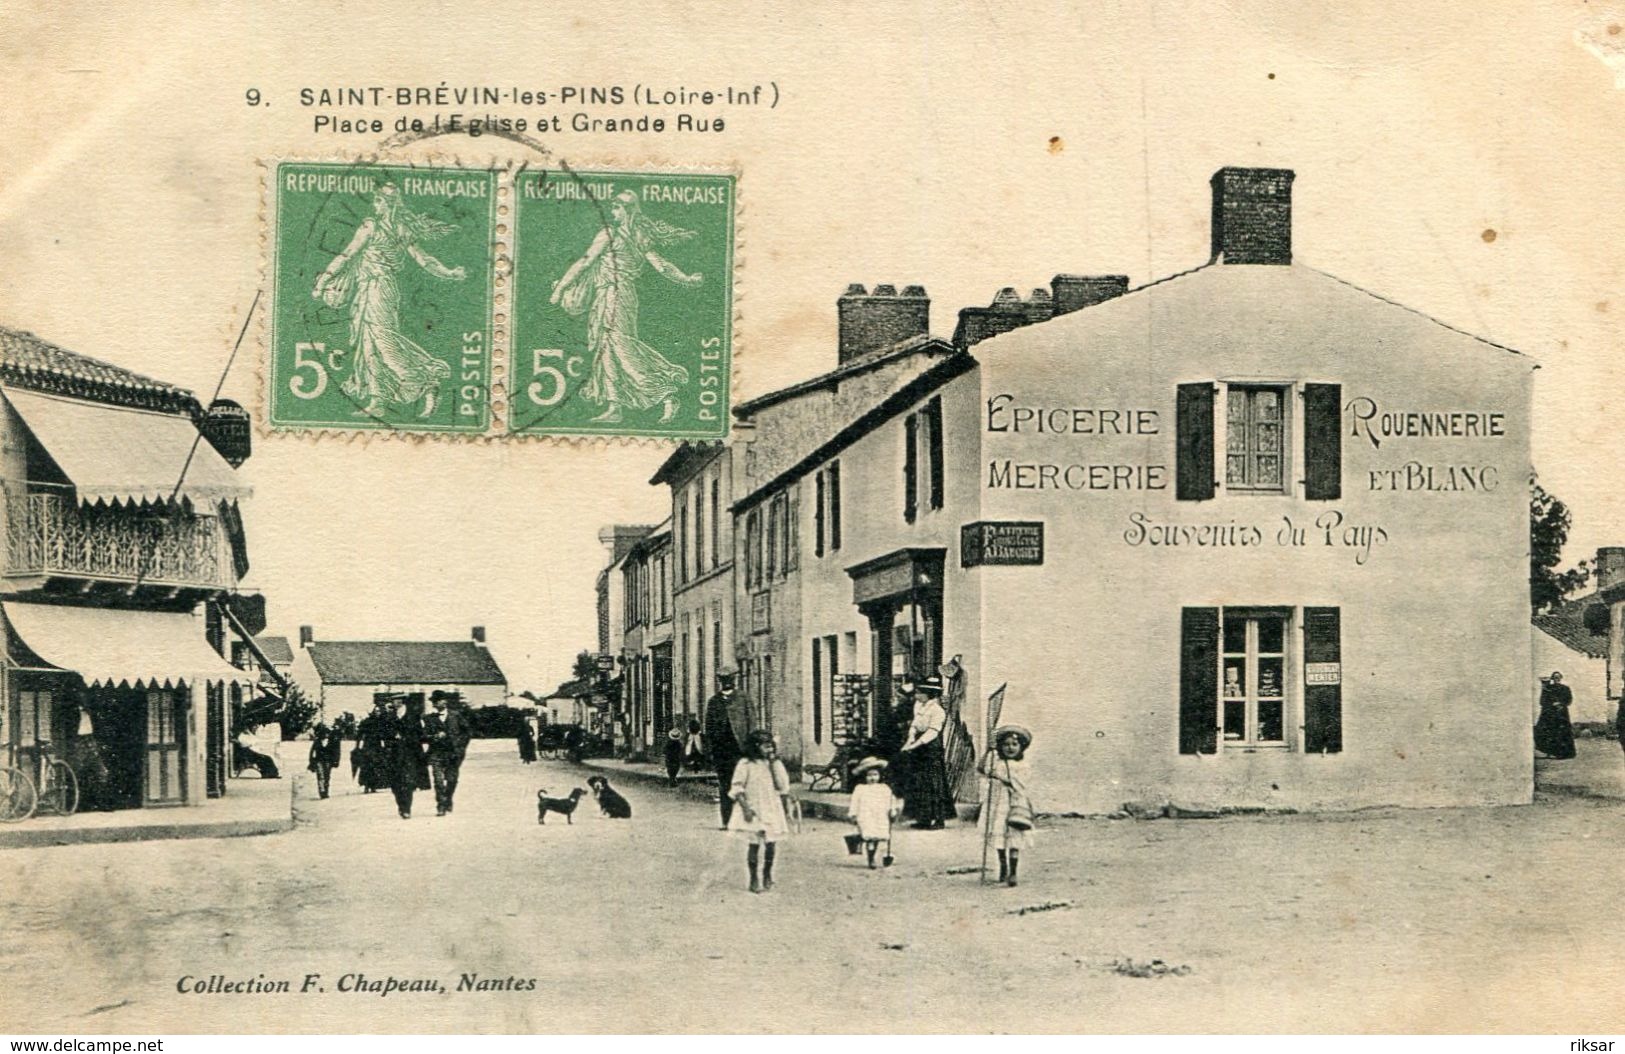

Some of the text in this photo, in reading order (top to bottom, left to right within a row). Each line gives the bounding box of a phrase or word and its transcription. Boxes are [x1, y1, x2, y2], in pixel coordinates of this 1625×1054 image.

[245, 88, 270, 106] 9.
[314, 115, 383, 133] Place
[394, 115, 423, 132] de
[537, 115, 562, 132] et
[571, 113, 665, 132] Grande
[677, 114, 726, 132] Rue
[403, 177, 488, 198] FRANÇAISE
[642, 184, 725, 205] FRANÇAISE
[460, 330, 483, 416] POSTES
[698, 336, 721, 421] POSTES
[987, 394, 1159, 435] EPICERIE
[1344, 396, 1505, 450] ROUENNERIE
[987, 460, 1167, 490] MERCERIE
[1369, 460, 1499, 492] ET BLANC
[1123, 510, 1388, 566] Souvenirs du Pays
[176, 973, 537, 997] Collection F. Chapeau, Nantes
